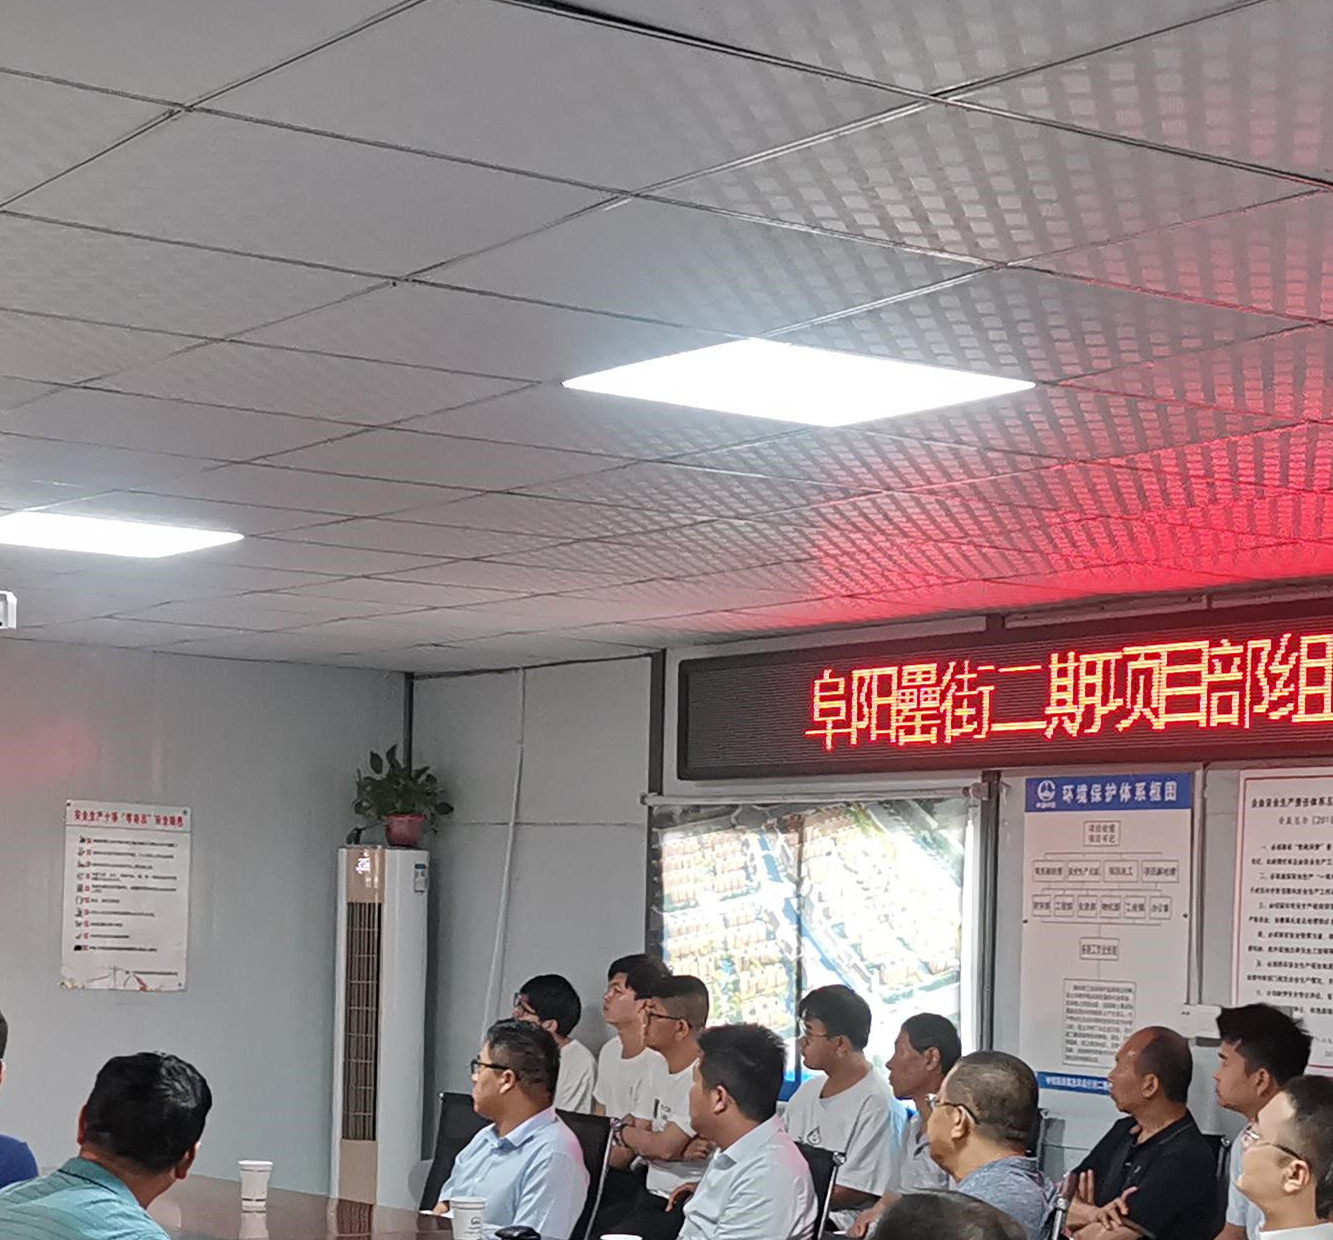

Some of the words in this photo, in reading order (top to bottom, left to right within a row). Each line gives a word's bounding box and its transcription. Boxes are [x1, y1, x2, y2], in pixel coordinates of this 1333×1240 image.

[1062, 780, 1178, 804] 环境保护体系框图
